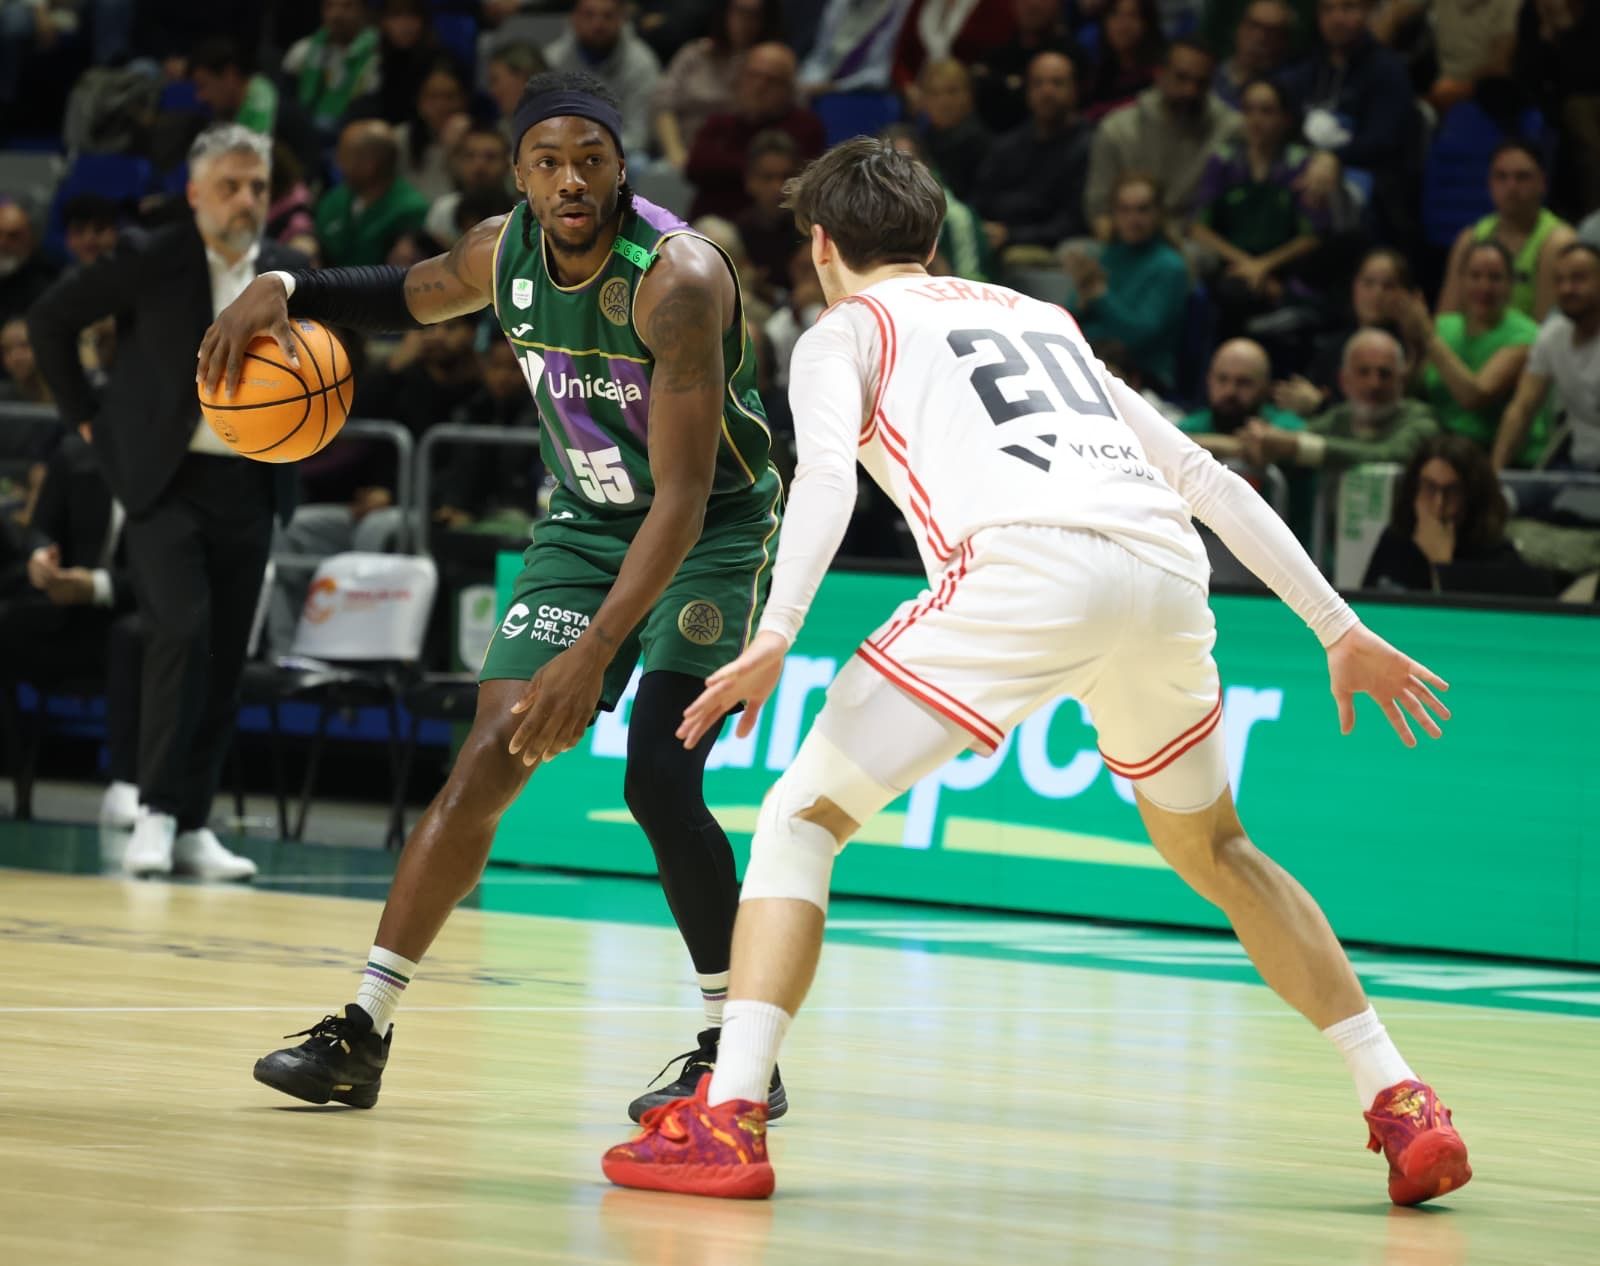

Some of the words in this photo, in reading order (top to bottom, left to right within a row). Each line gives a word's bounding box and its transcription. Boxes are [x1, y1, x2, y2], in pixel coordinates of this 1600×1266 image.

[903, 279, 1021, 310] LERAY
[548, 371, 643, 409] Unicaja
[946, 328, 1118, 426] 20
[565, 445, 635, 504] 55
[534, 618, 560, 633] DEL
[562, 624, 585, 639] SO
[538, 604, 590, 627] COSTA
